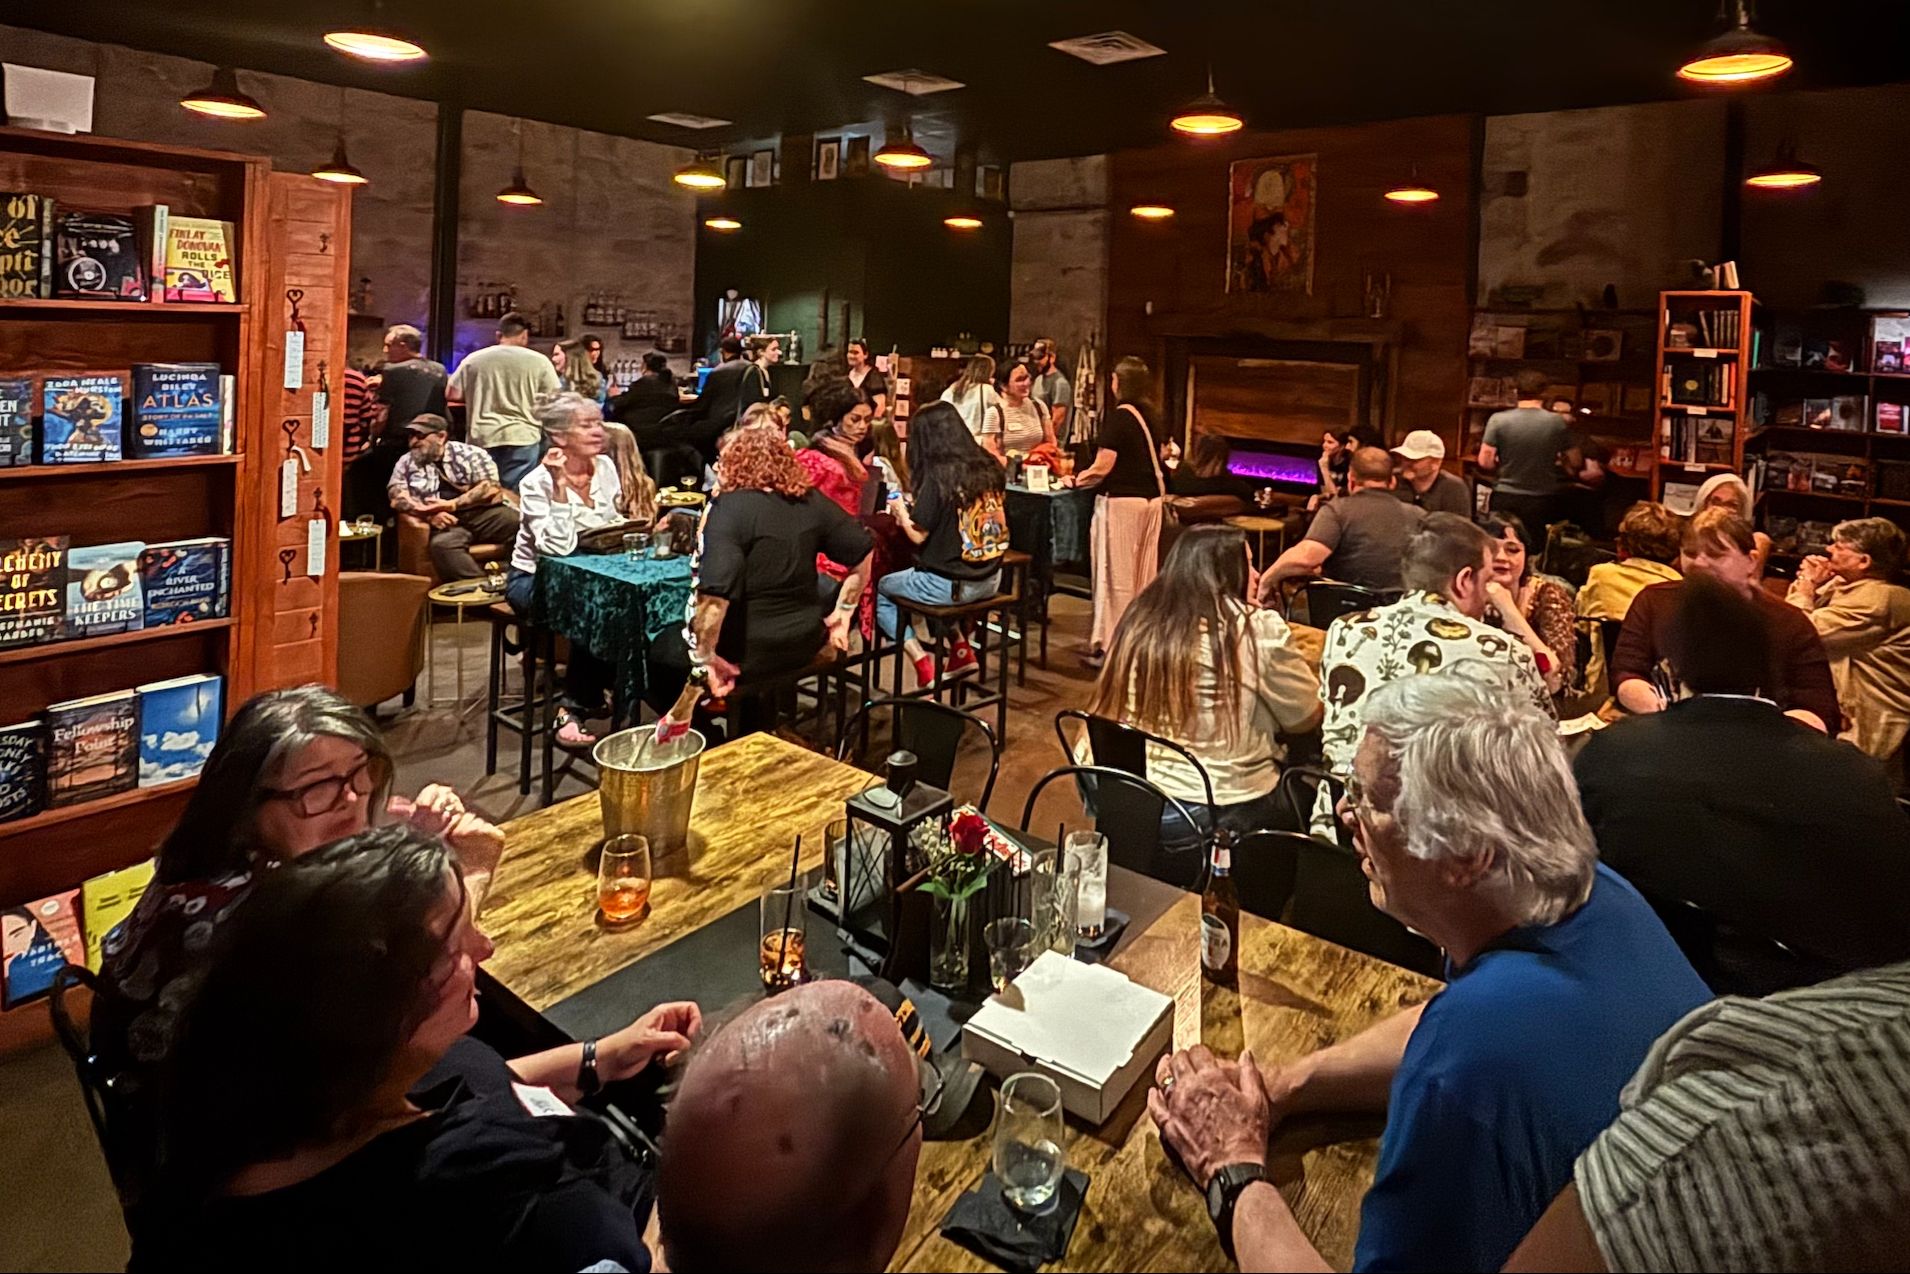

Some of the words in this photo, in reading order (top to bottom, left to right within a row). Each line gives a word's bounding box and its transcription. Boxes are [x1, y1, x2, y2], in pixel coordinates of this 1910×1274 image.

[169, 228, 206, 240] FINLAY
[177, 240, 223, 253] DONOVAN
[181, 251, 217, 260] ROLLS
[188, 260, 205, 268] THE
[152, 373, 207, 381] LUCINDA
[142, 392, 214, 408] ATLAS
[11, 573, 30, 589] OF
[165, 576, 199, 586] RIVER
[147, 582, 215, 598] ENCHANTED
[74, 609, 137, 626] KEEPERS
[53, 716, 135, 742] Fellowship
[75, 734, 118, 754] Point
